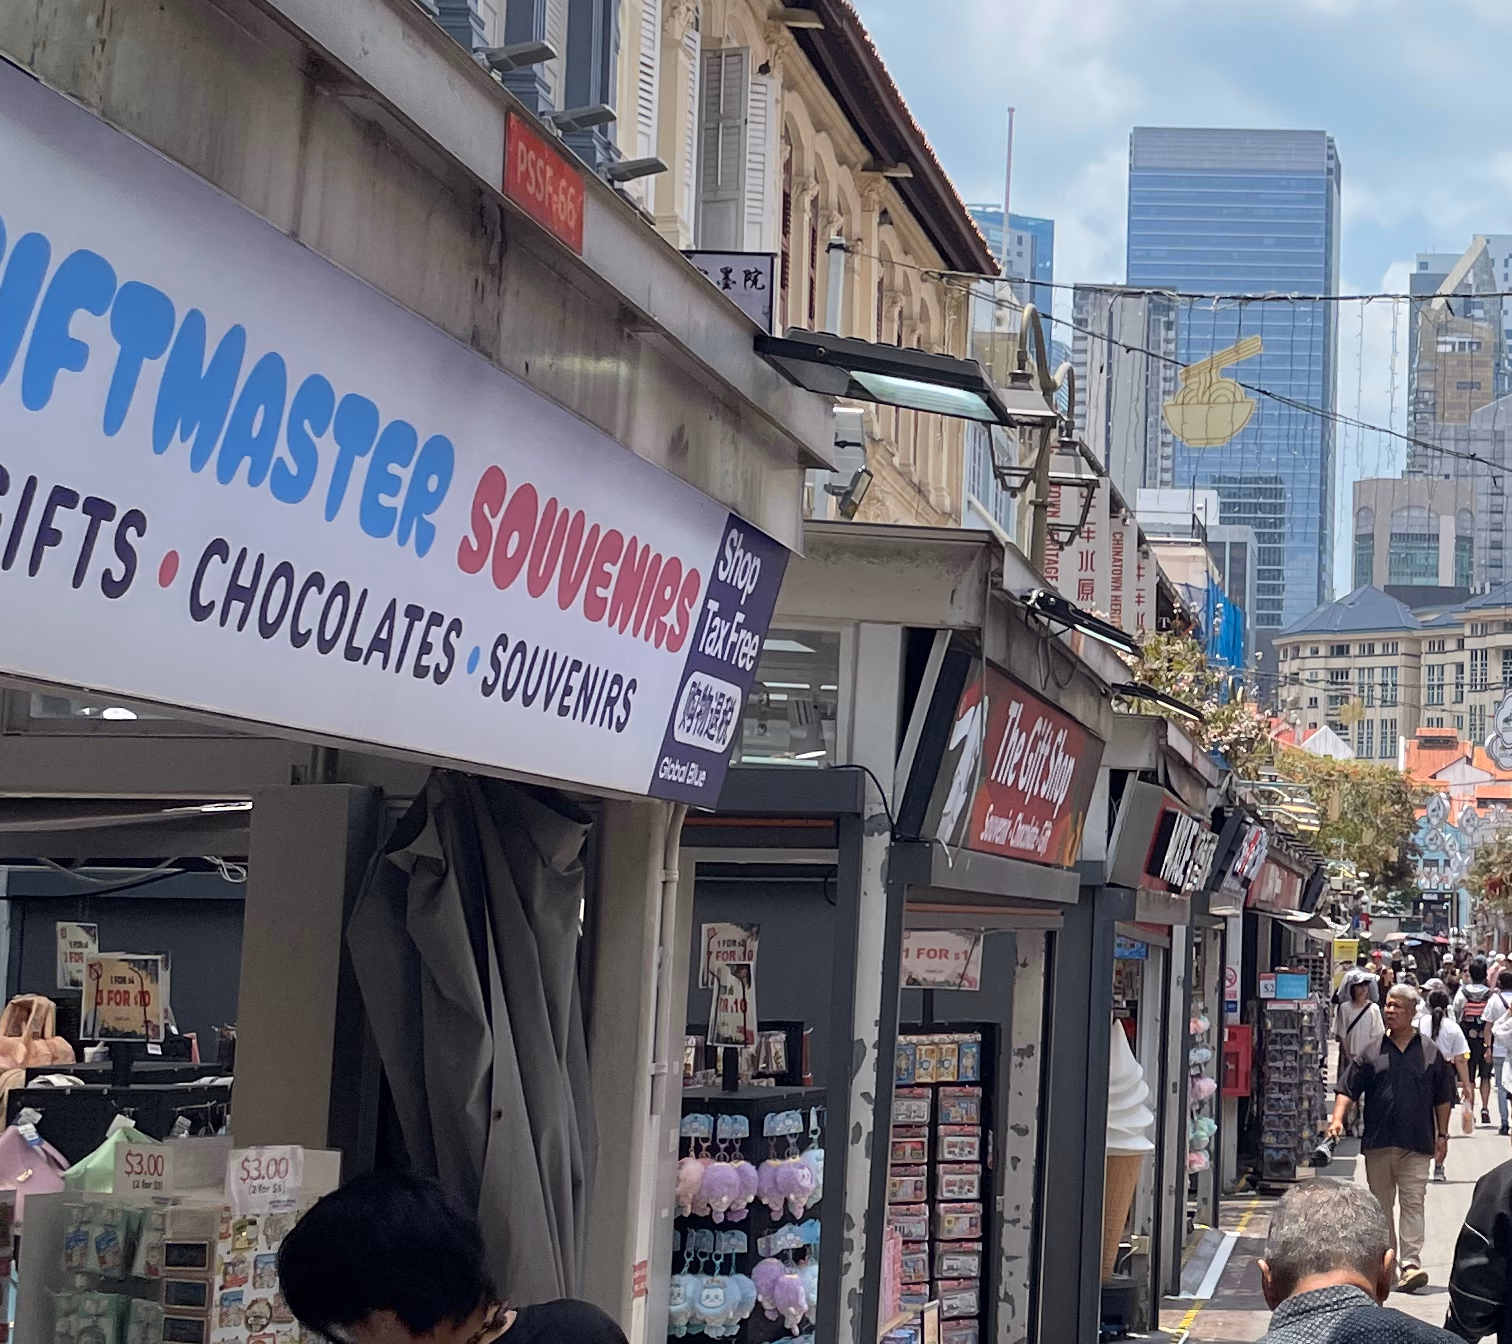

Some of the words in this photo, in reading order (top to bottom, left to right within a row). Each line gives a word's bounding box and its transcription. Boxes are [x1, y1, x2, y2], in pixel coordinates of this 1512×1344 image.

[0, 213, 455, 558] IFTMASTER
[456, 464, 702, 653] SOUVENIRS
[718, 528, 761, 606] Shop
[1111, 531, 1124, 592] CHINATOWN
[189, 537, 463, 686] CHOCOLATES
[481, 632, 638, 734] SOUVENIRS
[699, 598, 729, 663] Tax
[730, 611, 760, 672] Free
[659, 756, 689, 784] Global
[687, 763, 707, 788] Blue
[990, 699, 1027, 788] The
[1017, 715, 1054, 806] Gift
[1039, 728, 1076, 820] Shop
[916, 947, 950, 961] FOR
[106, 989, 131, 1007] FOR
[124, 1149, 165, 1177] $3.00
[240, 1156, 289, 1184] $3.00
